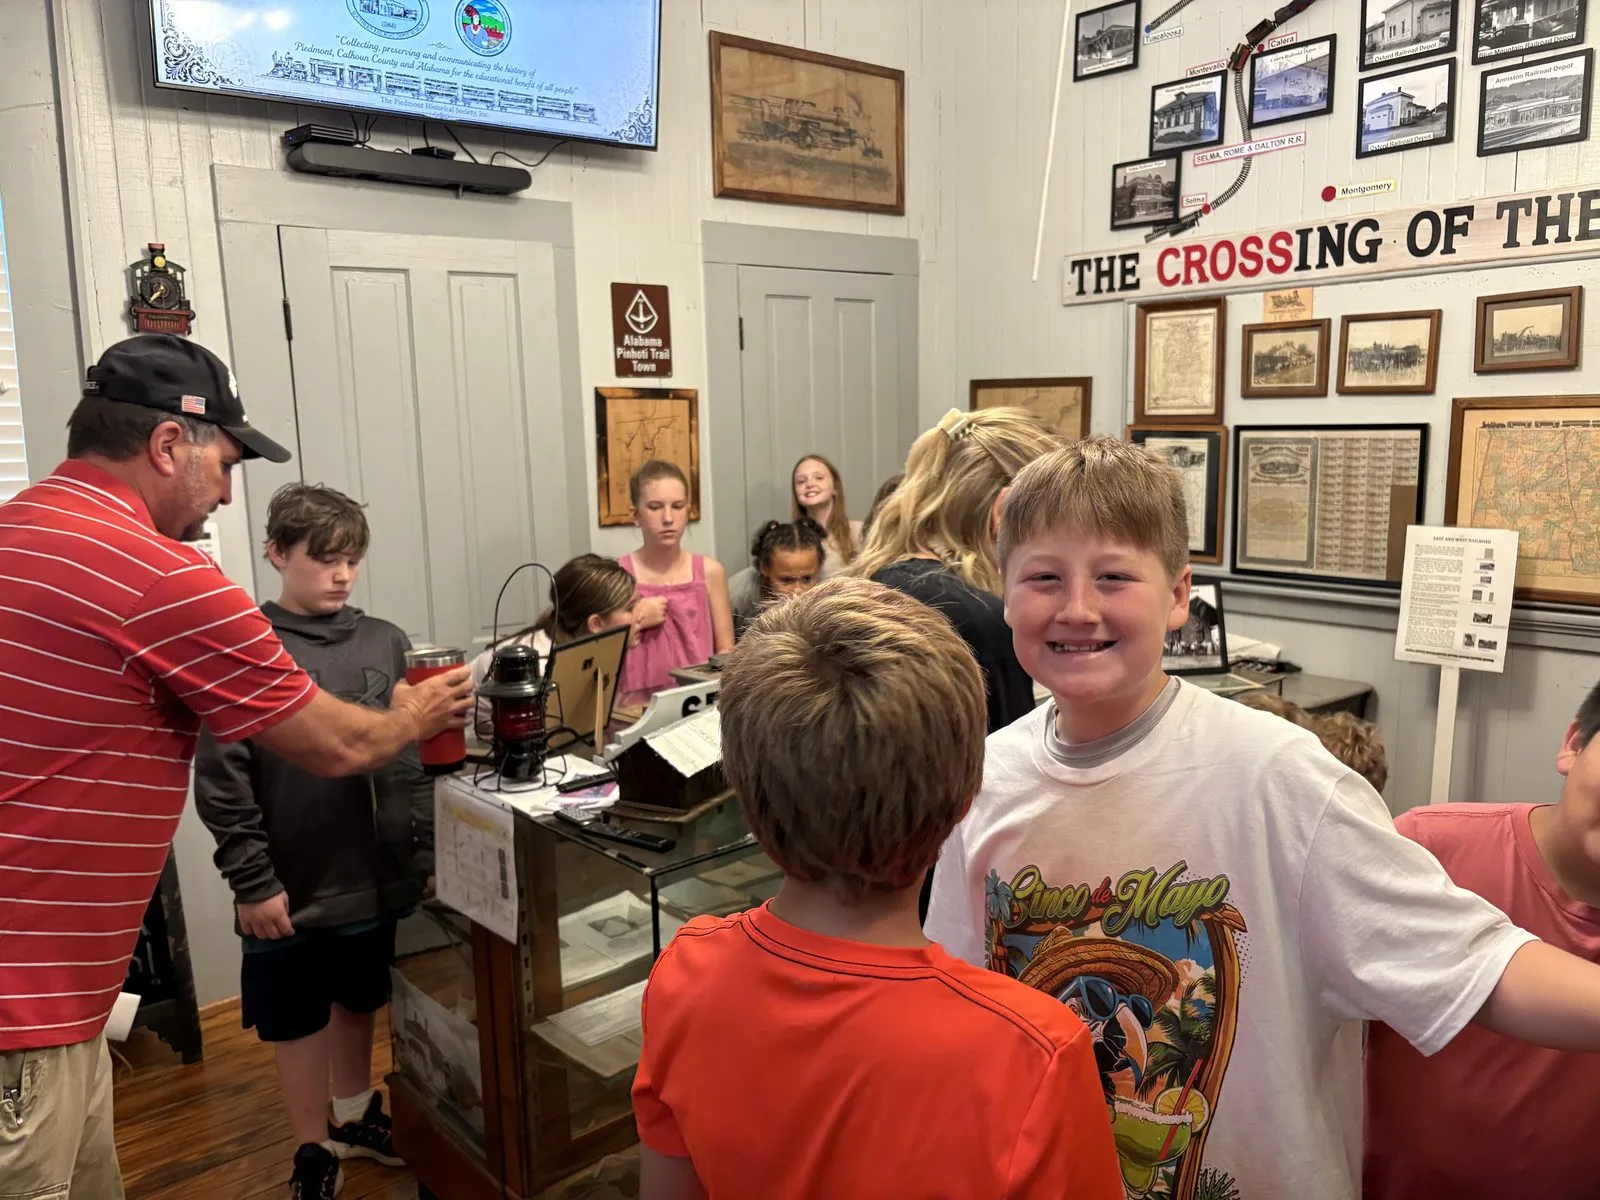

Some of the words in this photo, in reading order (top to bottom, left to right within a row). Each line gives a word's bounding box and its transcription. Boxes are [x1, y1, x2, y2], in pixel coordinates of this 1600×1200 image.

[1270, 36, 1295, 48] Calera
[1374, 52, 1394, 62] Oxford
[1394, 47, 1419, 57] Railroad
[1419, 42, 1437, 52] Depot
[1494, 45, 1524, 55] Mountain
[1524, 38, 1553, 49] Railroad
[1553, 33, 1575, 43] Depot
[294, 41, 335, 57] Piedmont,
[336, 49, 369, 61] Calhoun
[371, 54, 399, 68] County
[400, 60, 415, 69] and
[416, 62, 450, 75] Alabama
[450, 68, 462, 78] for
[463, 69, 474, 79] the
[475, 72, 513, 85] educational
[514, 79, 535, 90] benefit
[536, 81, 544, 92] of
[544, 83, 555, 91] all
[382, 45, 421, 60] preserving
[422, 51, 437, 60] and
[438, 54, 492, 71] communicating
[493, 62, 504, 71] the
[504, 65, 528, 77] history
[528, 69, 537, 78] of
[1189, 62, 1226, 76] Montevallo
[1495, 73, 1524, 84] Anniston
[1524, 67, 1552, 78] Railroad
[1553, 62, 1574, 72] Depot
[1196, 152, 1222, 163] SELMA,
[1223, 146, 1246, 157] ROME
[1254, 138, 1286, 151] DALTON
[1287, 135, 1304, 145] R.R.
[1369, 142, 1389, 151] Oxford
[1389, 138, 1414, 147] Railroad
[1414, 134, 1432, 143] Depot
[1341, 182, 1392, 195] Montgomery
[1185, 195, 1205, 205] Selma
[1071, 252, 1141, 296] THE
[1156, 218, 1383, 287] CROSSING
[1406, 205, 1475, 258] OF
[1496, 189, 1600, 249] THE
[623, 334, 662, 347] Alabama
[616, 347, 648, 359] Pinhoti
[650, 348, 670, 360] Trail
[632, 360, 656, 372] Town
[1004, 864, 1091, 928] Cinco
[1091, 876, 1112, 908] de
[1100, 859, 1230, 936] Mayo
